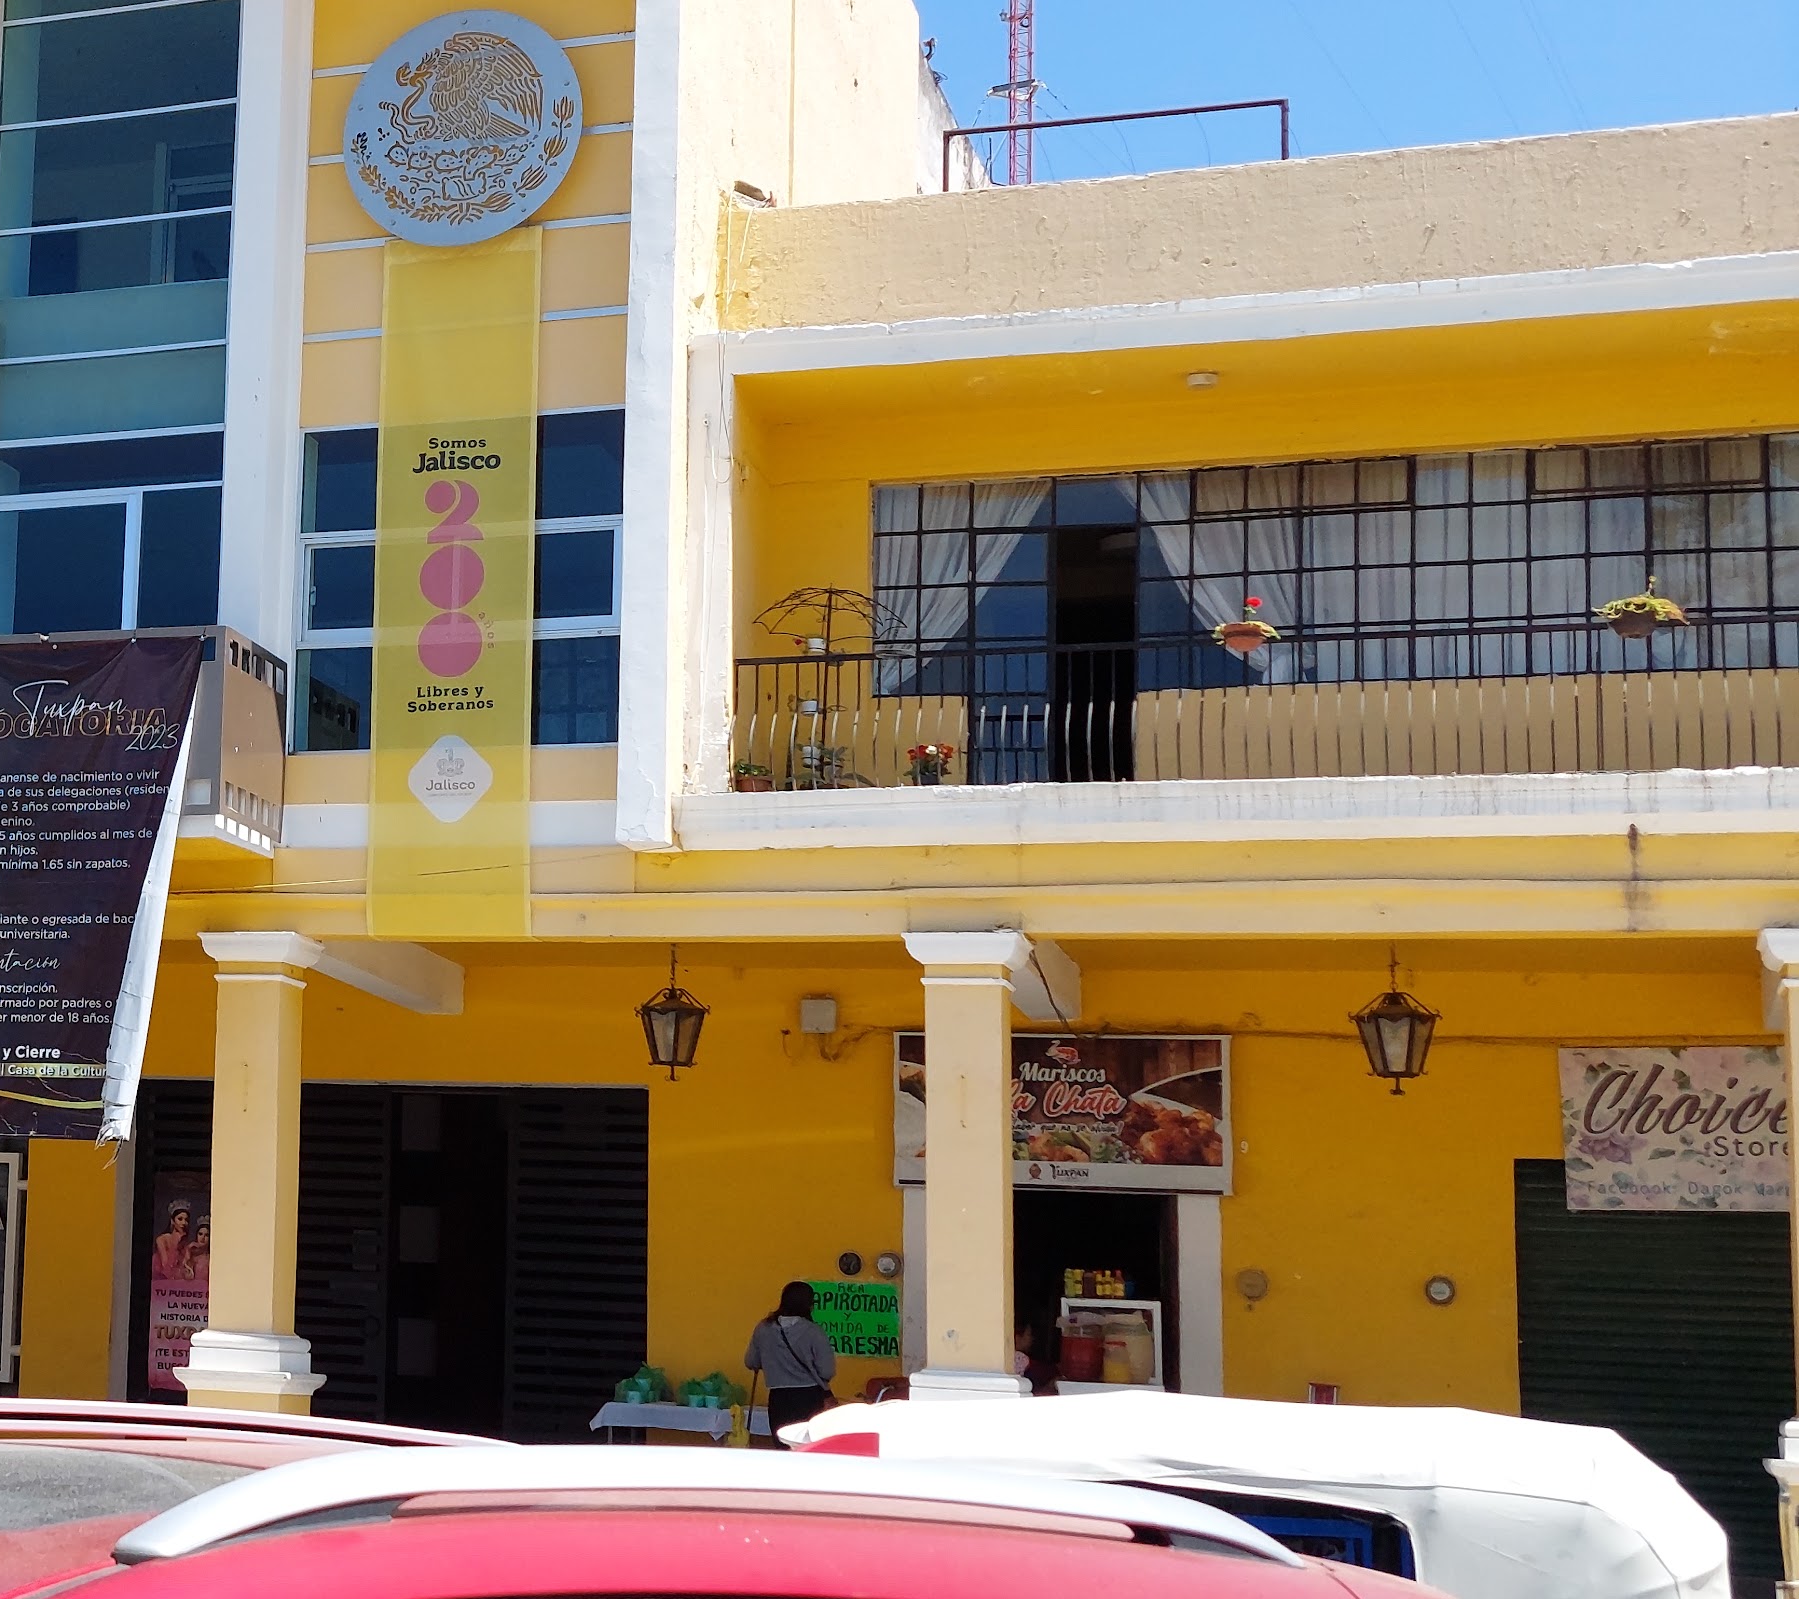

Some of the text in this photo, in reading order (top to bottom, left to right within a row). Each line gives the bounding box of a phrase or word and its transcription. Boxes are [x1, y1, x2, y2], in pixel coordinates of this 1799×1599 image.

[428, 436, 487, 450] Somos
[412, 451, 501, 474] Jalisco
[417, 685, 485, 698] Libres y
[13, 680, 126, 736] Tuxpan
[407, 699, 495, 713] Soberanos
[125, 723, 181, 751] 2023
[42, 772, 57, 782] de
[60, 771, 123, 782] nacimiento
[126, 772, 134, 781] o
[136, 769, 160, 780] vivir
[425, 778, 476, 791] Jalisco
[7, 786, 22, 797] de
[25, 788, 44, 797] sus
[47, 785, 122, 798] delegaciones
[11, 802, 19, 811] 3
[21, 801, 49, 812] años
[51, 799, 131, 812] comprobable)
[8, 830, 36, 841] años
[38, 829, 97, 843] cumplidos
[99, 829, 110, 839] al
[112, 830, 135, 839] mes
[137, 828, 153, 839] de
[10, 844, 39, 857] hijos.
[42, 859, 64, 870] 1.65
[66, 858, 83, 869] sin
[85, 858, 131, 870] zapatos.
[31, 916, 40, 924] o
[42, 913, 92, 927] egresada
[95, 913, 110, 924] de
[0, 929, 70, 939] universitaria.
[38, 999, 60, 1011] por
[62, 997, 102, 1010] padres
[104, 1000, 113, 1008] o
[10, 1014, 46, 1023] menor
[49, 1011, 64, 1023] de
[67, 1012, 79, 1023] 18
[82, 1011, 112, 1024] años.
[2, 1047, 12, 1060] y
[15, 1045, 61, 1059] Cierre
[8, 1064, 35, 1075] Casa
[39, 1065, 55, 1076] de
[57, 1066, 68, 1076] la
[1018, 1061, 1106, 1082] Mariscos
[1043, 1080, 1128, 1121] Chata
[1240, 1140, 1249, 1154] 9
[155, 1289, 167, 1297] TU
[169, 1290, 203, 1299] PUEDES
[837, 1282, 865, 1293] RICA
[161, 1313, 200, 1322] HISTORIA
[876, 1324, 889, 1333] DE
